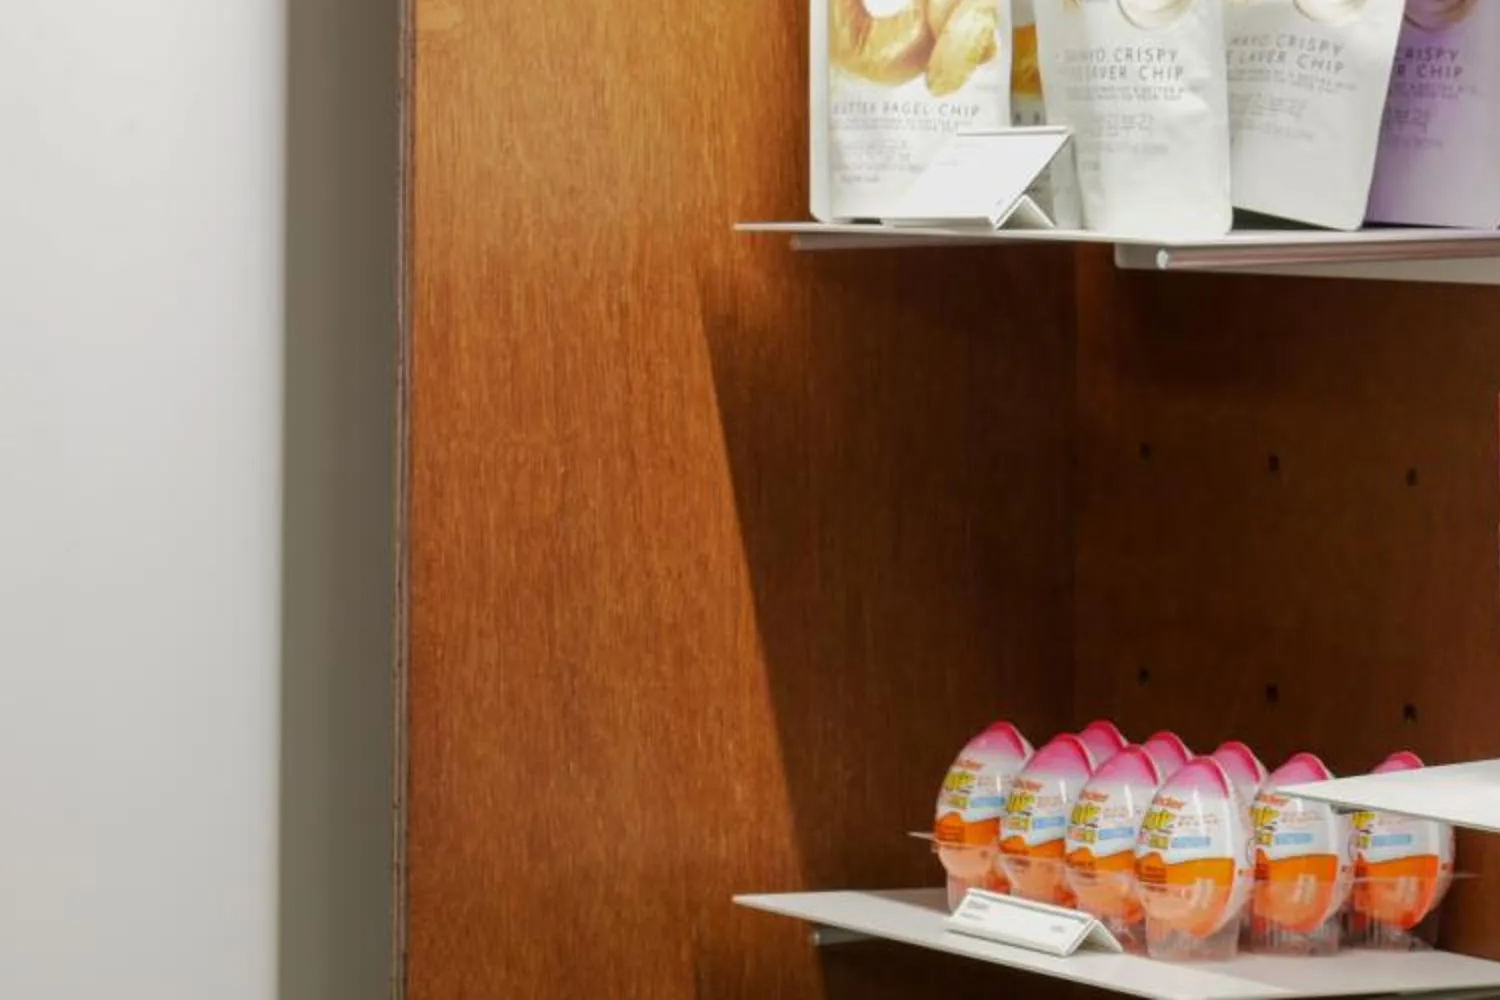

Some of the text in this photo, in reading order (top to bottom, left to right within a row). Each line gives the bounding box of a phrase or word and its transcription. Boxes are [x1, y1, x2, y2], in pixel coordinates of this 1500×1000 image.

[1275, 33, 1345, 57] CRISPY
[1114, 47, 1179, 63] CRISPY
[1296, 53, 1346, 74] CHIP
[1138, 65, 1184, 82] CHIP
[1416, 65, 1464, 79] CHIP
[882, 100, 930, 116] BAGEL
[938, 101, 981, 118] CHIP
